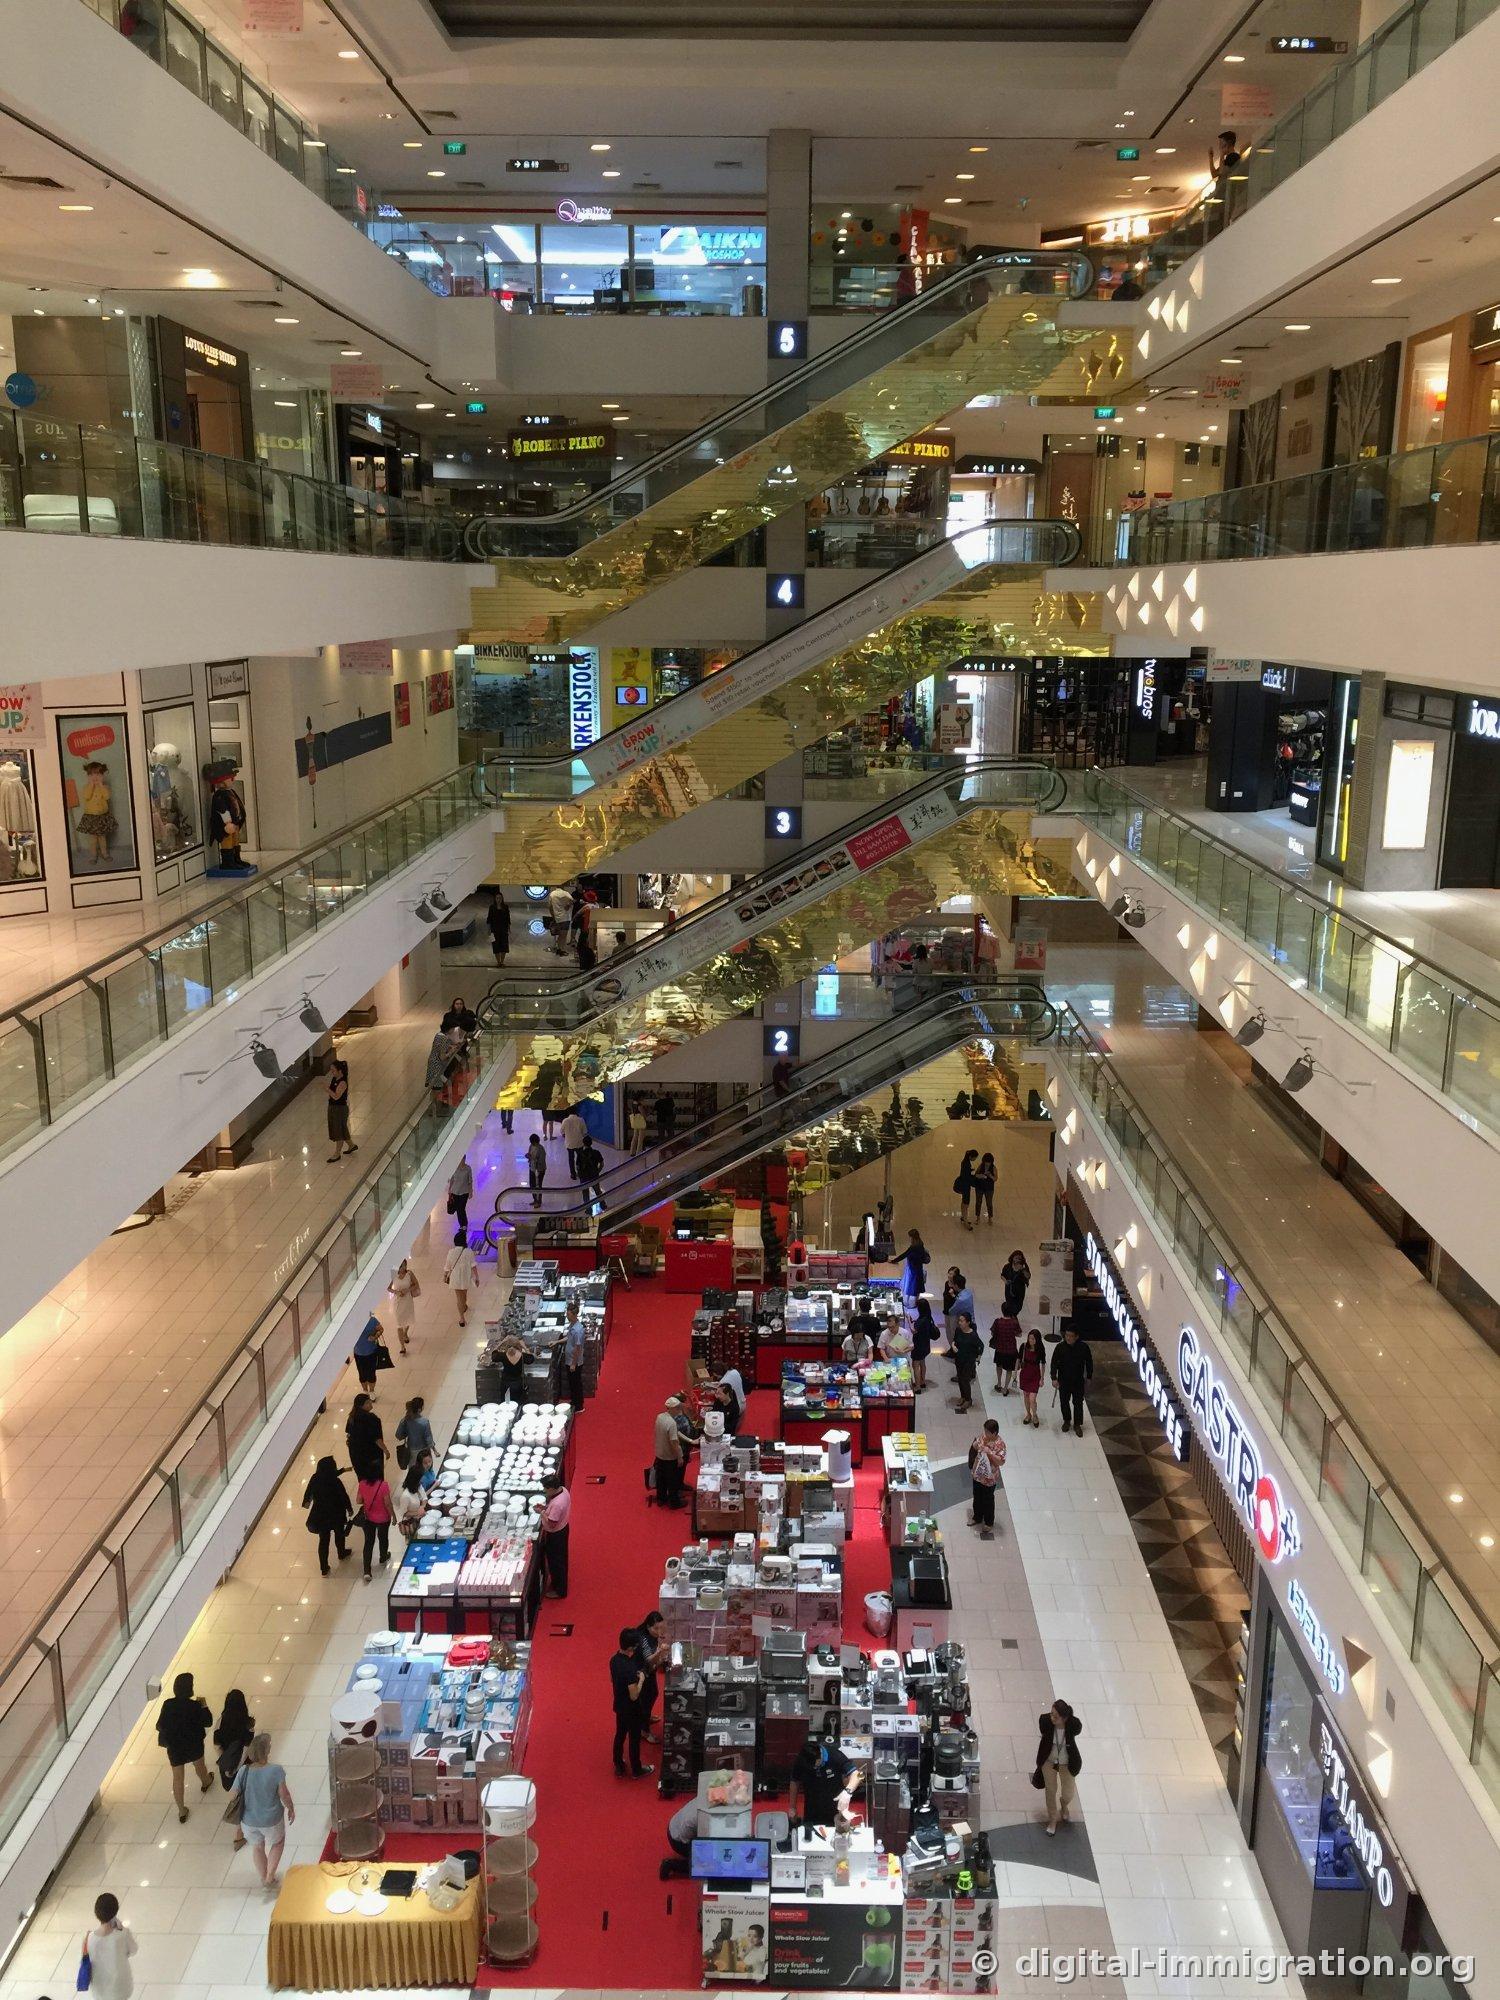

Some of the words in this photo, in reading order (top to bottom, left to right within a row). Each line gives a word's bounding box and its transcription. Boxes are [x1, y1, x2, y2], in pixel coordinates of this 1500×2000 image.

[184, 335, 205, 354] LOTUS
[780, 327, 794, 353] 5
[522, 438, 566, 453] ROBERT
[568, 435, 605, 451] PIANO
[913, 442, 950, 458] PIANO
[777, 579, 793, 603] 4
[804, 621, 843, 647] Centrepoint
[474, 645, 529, 659] BIRKENSTOCK
[571, 651, 593, 751] IRKENSTOCK
[1470, 700, 1500, 738] iOR
[623, 724, 655, 749] GROW
[777, 812, 790, 833] 3
[854, 833, 873, 848] NOW
[873, 822, 893, 837] OPEN
[775, 1031, 790, 1052] 2
[1086, 1231, 1139, 1363] STARBUCKS
[1138, 1346, 1183, 1462] COFFEE
